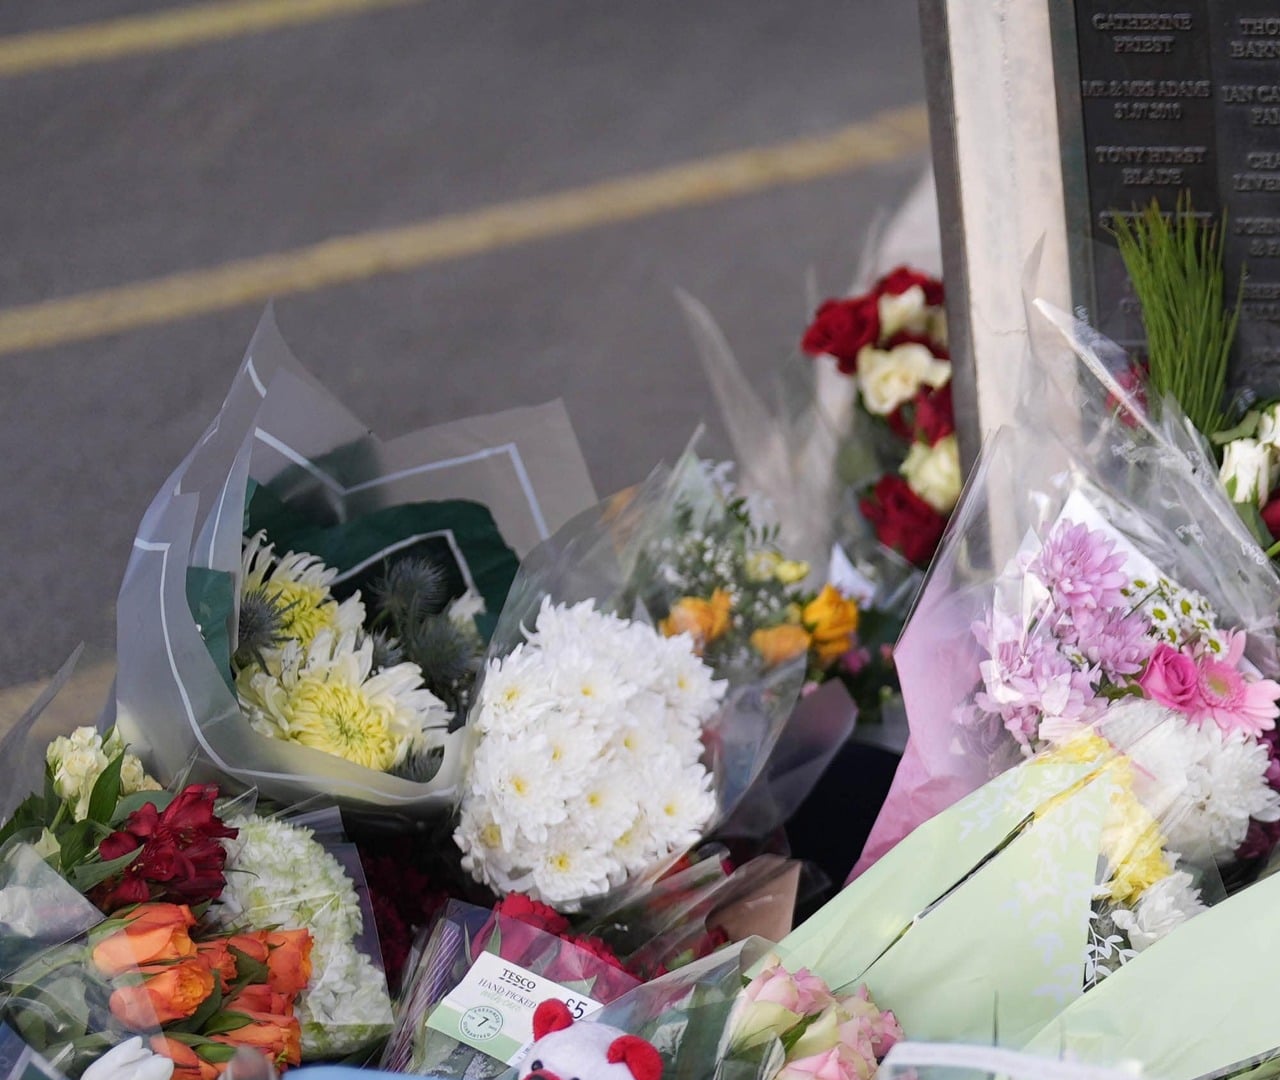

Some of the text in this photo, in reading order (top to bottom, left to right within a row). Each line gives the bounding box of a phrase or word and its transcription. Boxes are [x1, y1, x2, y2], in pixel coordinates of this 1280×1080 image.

[1221, 85, 1254, 103] IAN
[502, 967, 537, 990] TESCO
[564, 997, 589, 1020] £5
[476, 1015, 490, 1027] 7
